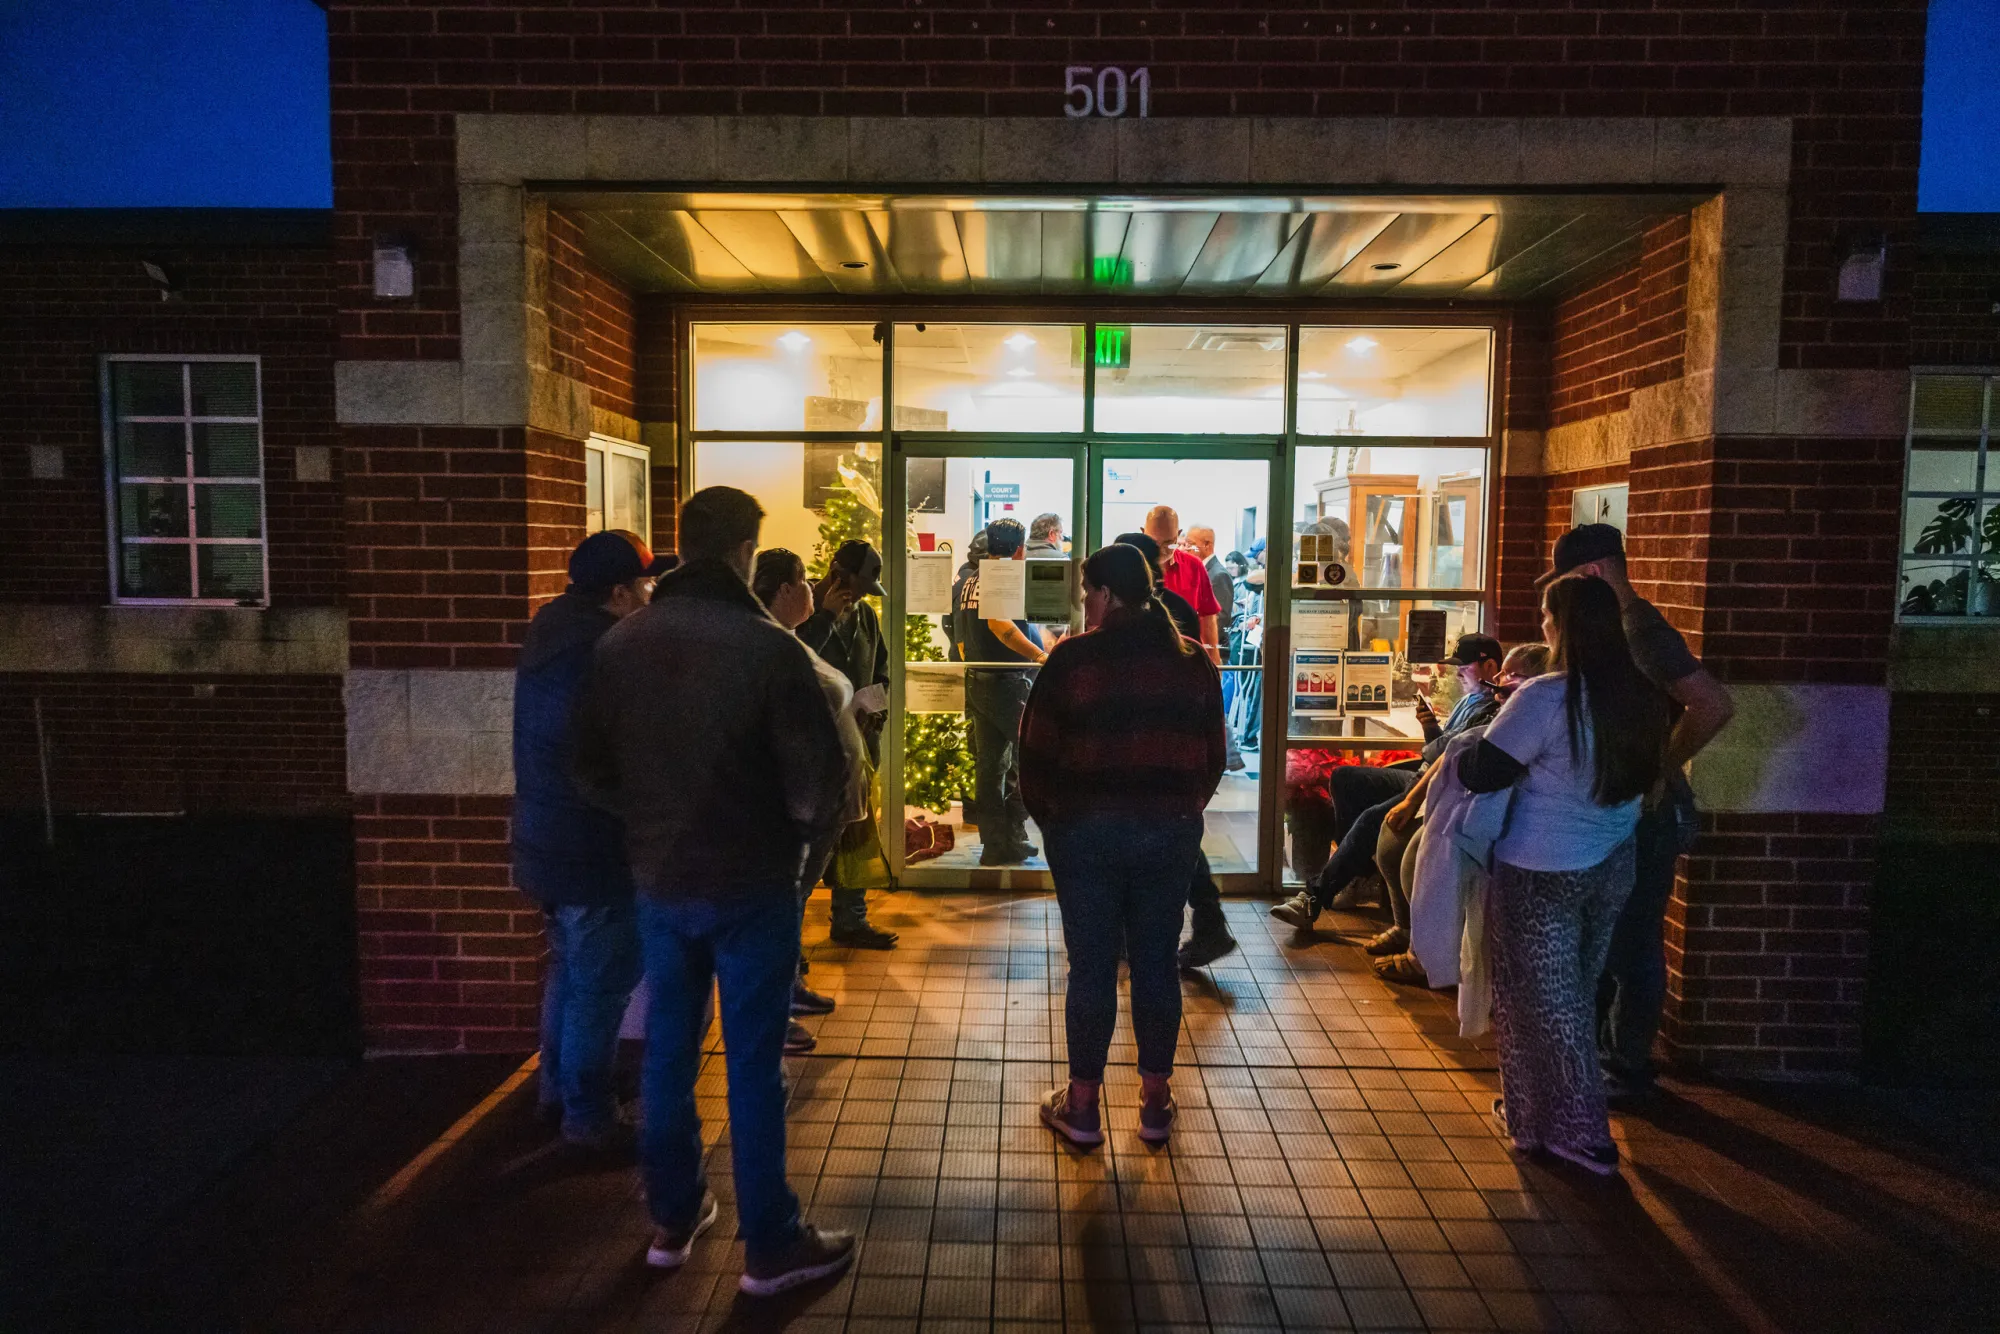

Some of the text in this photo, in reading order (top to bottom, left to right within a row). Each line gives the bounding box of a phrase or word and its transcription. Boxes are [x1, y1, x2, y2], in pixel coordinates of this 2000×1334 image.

[1063, 66, 1150, 118] 501
[1081, 331, 1124, 364] XIT
[1036, 615, 1059, 624] Smoking
